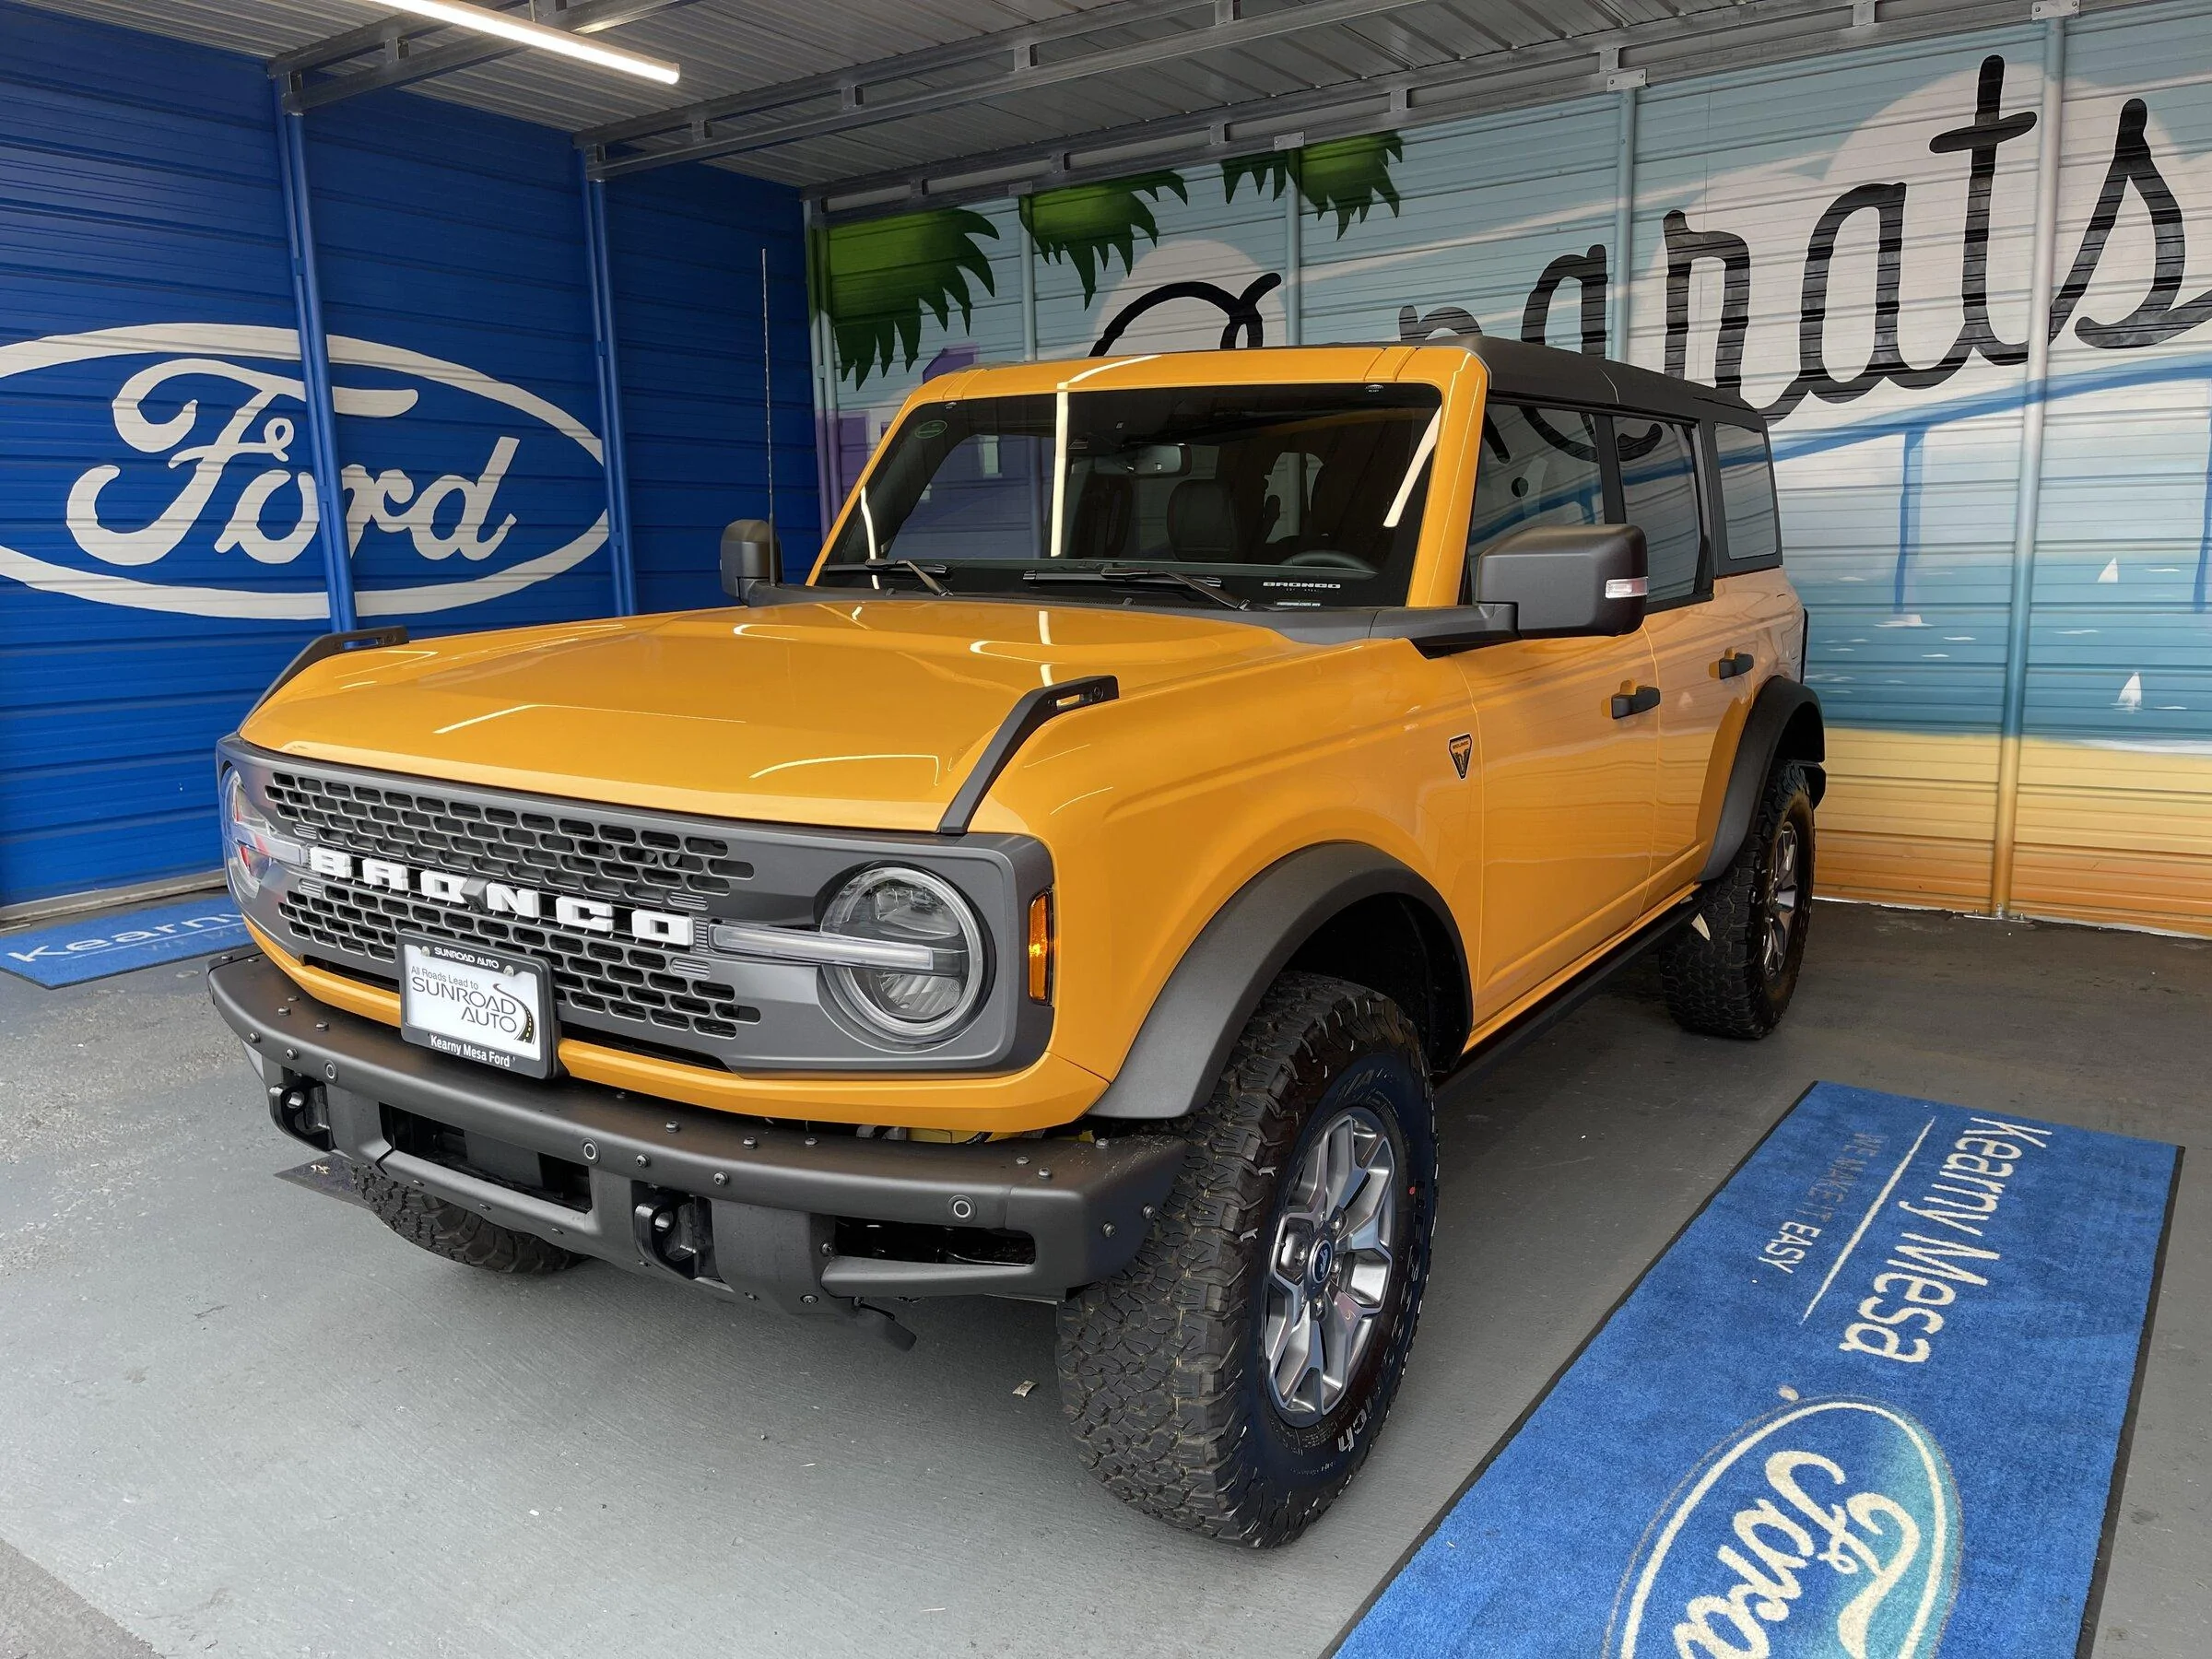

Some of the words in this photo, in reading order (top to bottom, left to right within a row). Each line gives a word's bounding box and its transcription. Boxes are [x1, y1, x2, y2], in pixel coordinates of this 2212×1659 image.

[66, 358, 519, 566] Ford
[310, 846, 694, 947] BRONCO
[411, 966, 421, 976] All
[422, 968, 447, 982] Roads
[448, 974, 468, 988] Lead
[470, 980, 479, 991] to
[434, 947, 475, 963] SUNROAD
[477, 957, 500, 969] AUTO
[412, 977, 516, 1015] SUNROAD
[461, 1006, 517, 1033] AUTO
[430, 1034, 462, 1055] Kearny
[463, 1043, 487, 1061] Mesa
[488, 1051, 511, 1067] Ford
[1899, 1117, 2053, 1236] Kearny
[1758, 1221, 1823, 1274] EASY
[1839, 1232, 2000, 1363] Mesa
